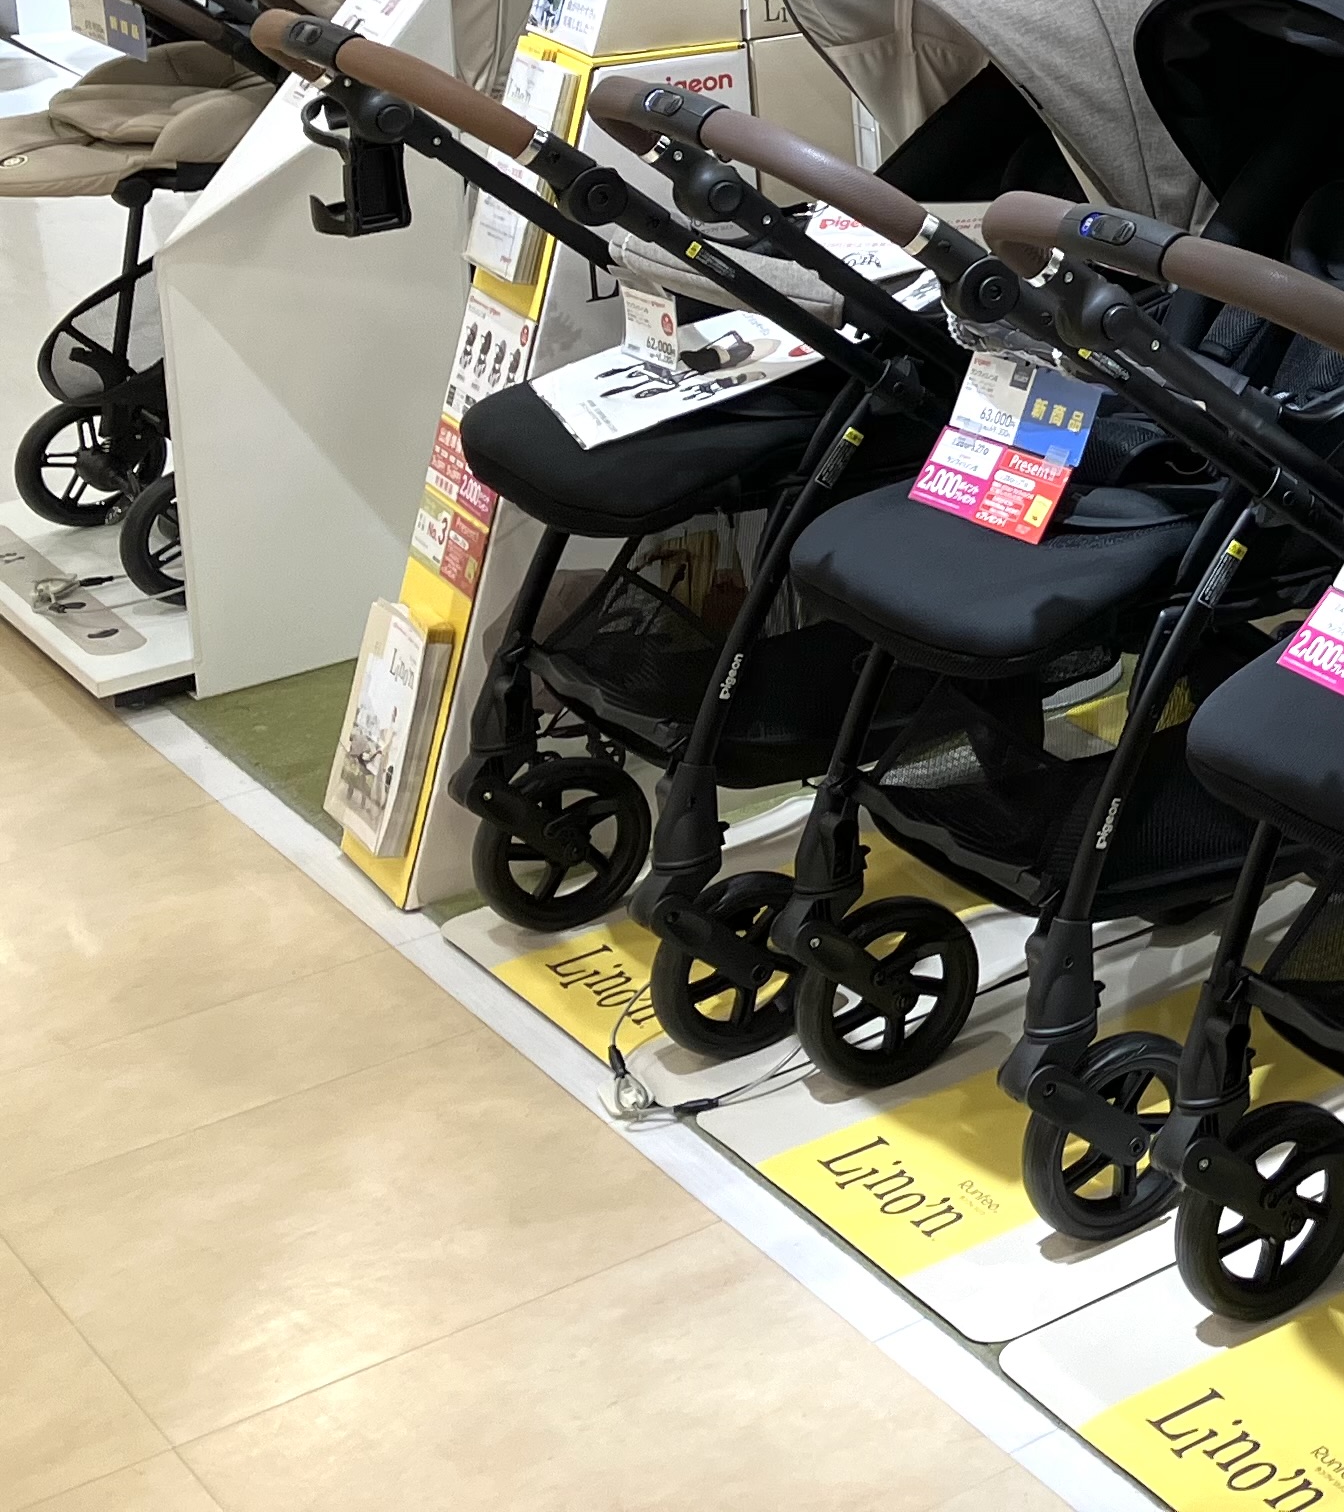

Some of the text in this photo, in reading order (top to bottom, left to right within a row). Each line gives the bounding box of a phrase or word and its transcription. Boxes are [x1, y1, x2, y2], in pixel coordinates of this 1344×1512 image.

[1288, 629, 1344, 673] 2,000
[718, 652, 744, 701] pigeon
[816, 1135, 965, 1239] Lino'n
